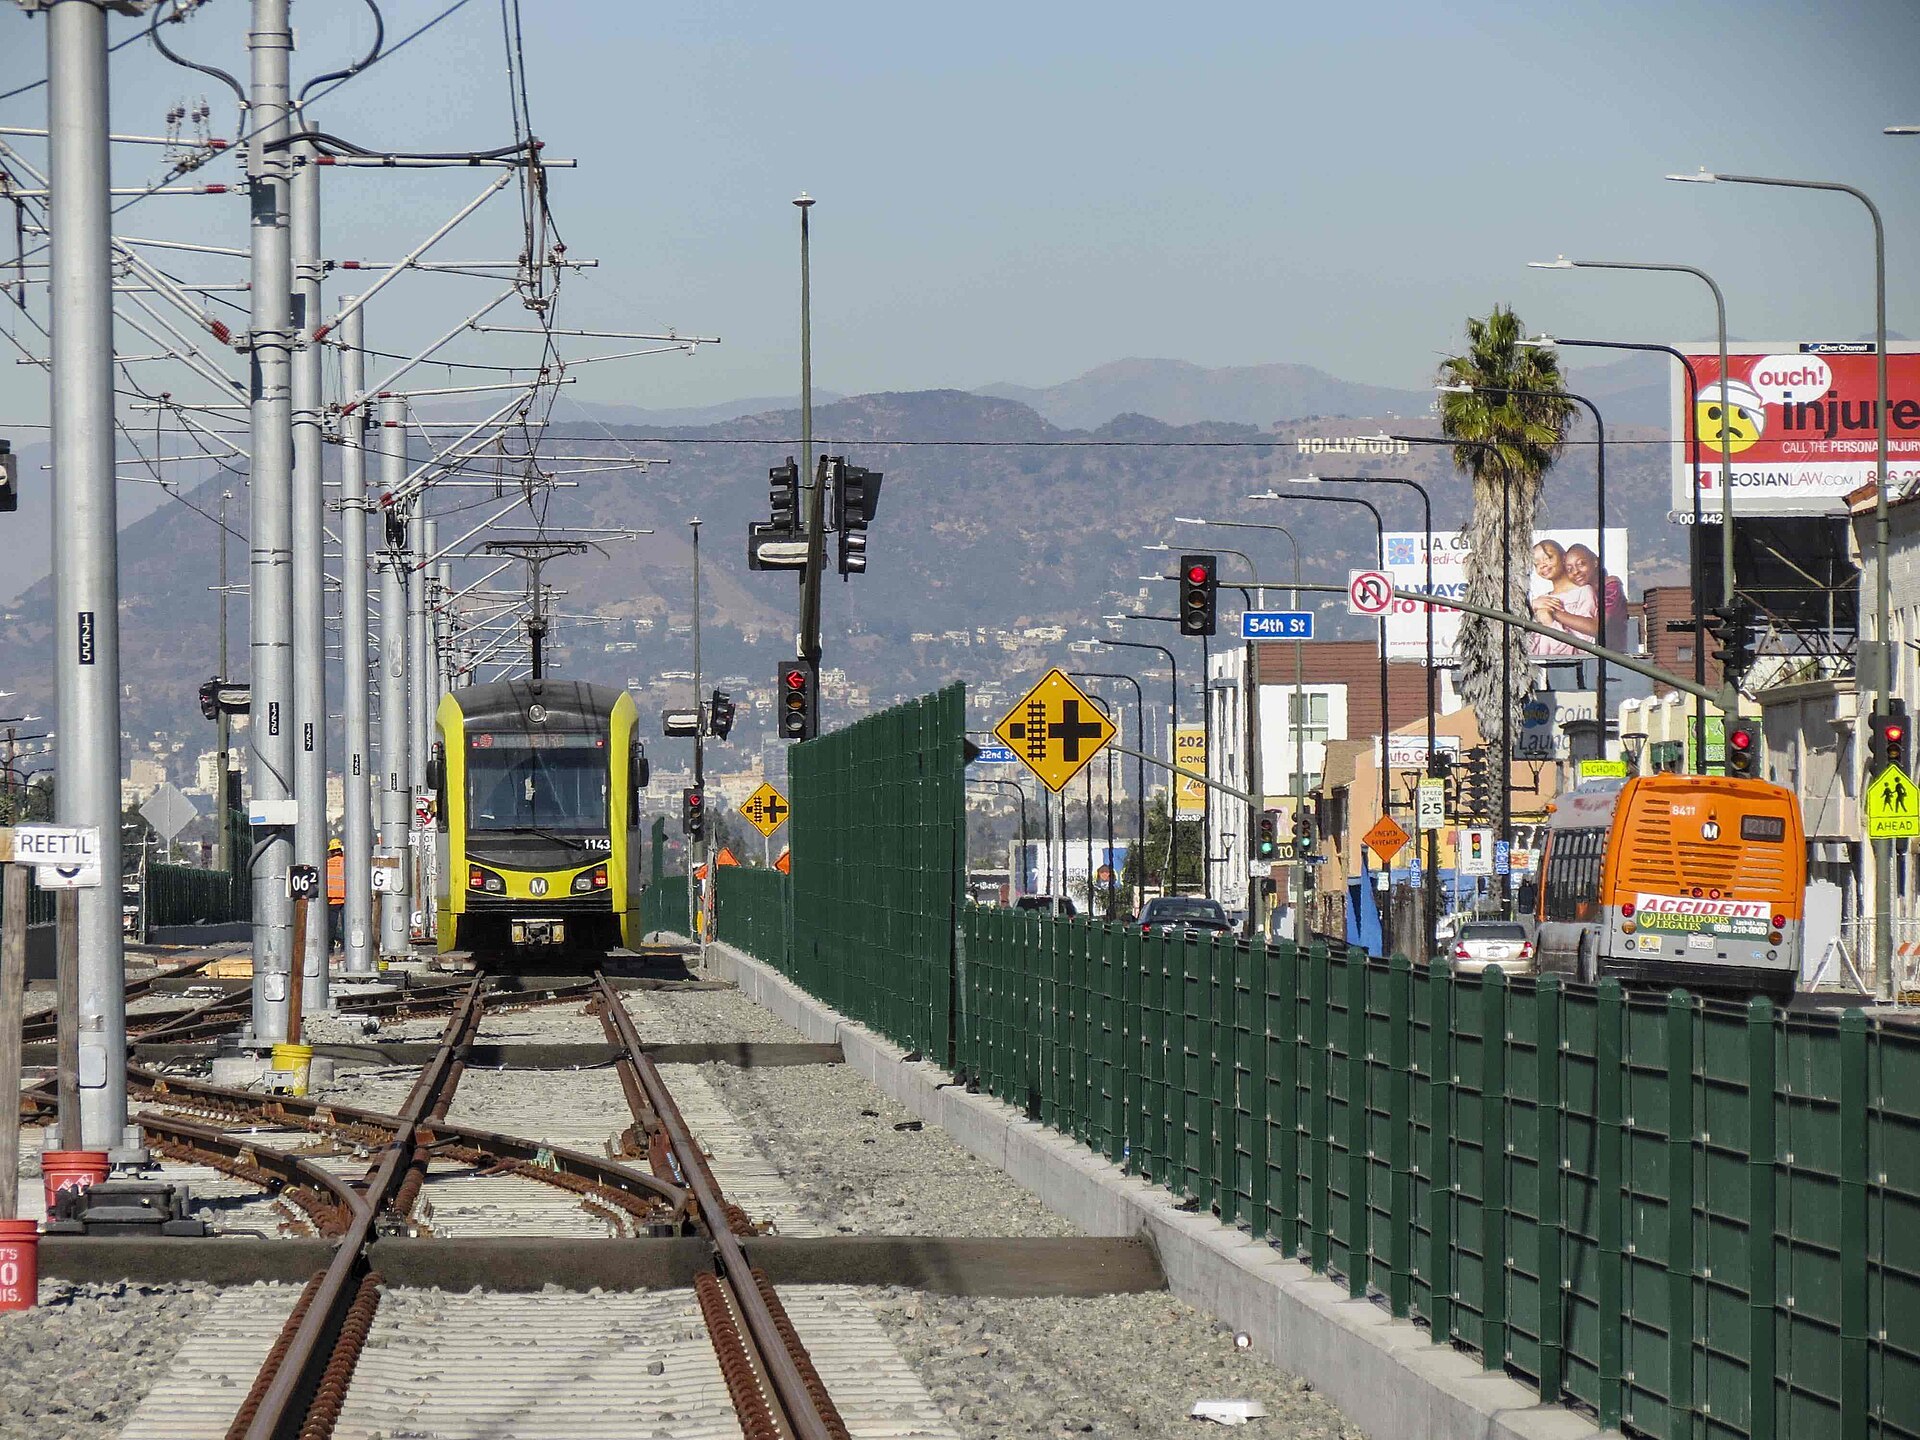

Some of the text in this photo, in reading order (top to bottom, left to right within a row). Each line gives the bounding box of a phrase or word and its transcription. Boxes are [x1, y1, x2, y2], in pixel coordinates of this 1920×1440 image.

[1819, 344, 1868, 352] Clear Channel
[1759, 366, 1824, 386] ouch!
[1297, 436, 1409, 455] HOLLYWOOD
[1782, 441, 1808, 454] CALL
[1810, 441, 1829, 453] THE
[1830, 441, 1883, 453] PERSONA
[1679, 513, 1724, 525] 00442
[1249, 618, 1306, 633] 54th St
[81, 613, 92, 662] 1255
[1420, 658, 1454, 668] 02440
[270, 702, 278, 735] 1256
[1554, 705, 1592, 723] Coin
[305, 723, 313, 750] 1257
[1178, 736, 1205, 748] 202
[1003, 750, 1014, 760] St
[1421, 803, 1443, 815] 25
[1671, 805, 1696, 816] 8411
[1703, 823, 1719, 839] M
[1876, 820, 1913, 831] AHEAD
[14, 834, 72, 854] REET
[584, 839, 611, 850] 1143
[373, 870, 384, 887] G
[531, 879, 547, 894] M
[1642, 898, 1767, 918] ACCIDENT
[1656, 911, 1730, 925] LUCHADORES
[1656, 919, 1702, 932] LEGALES
